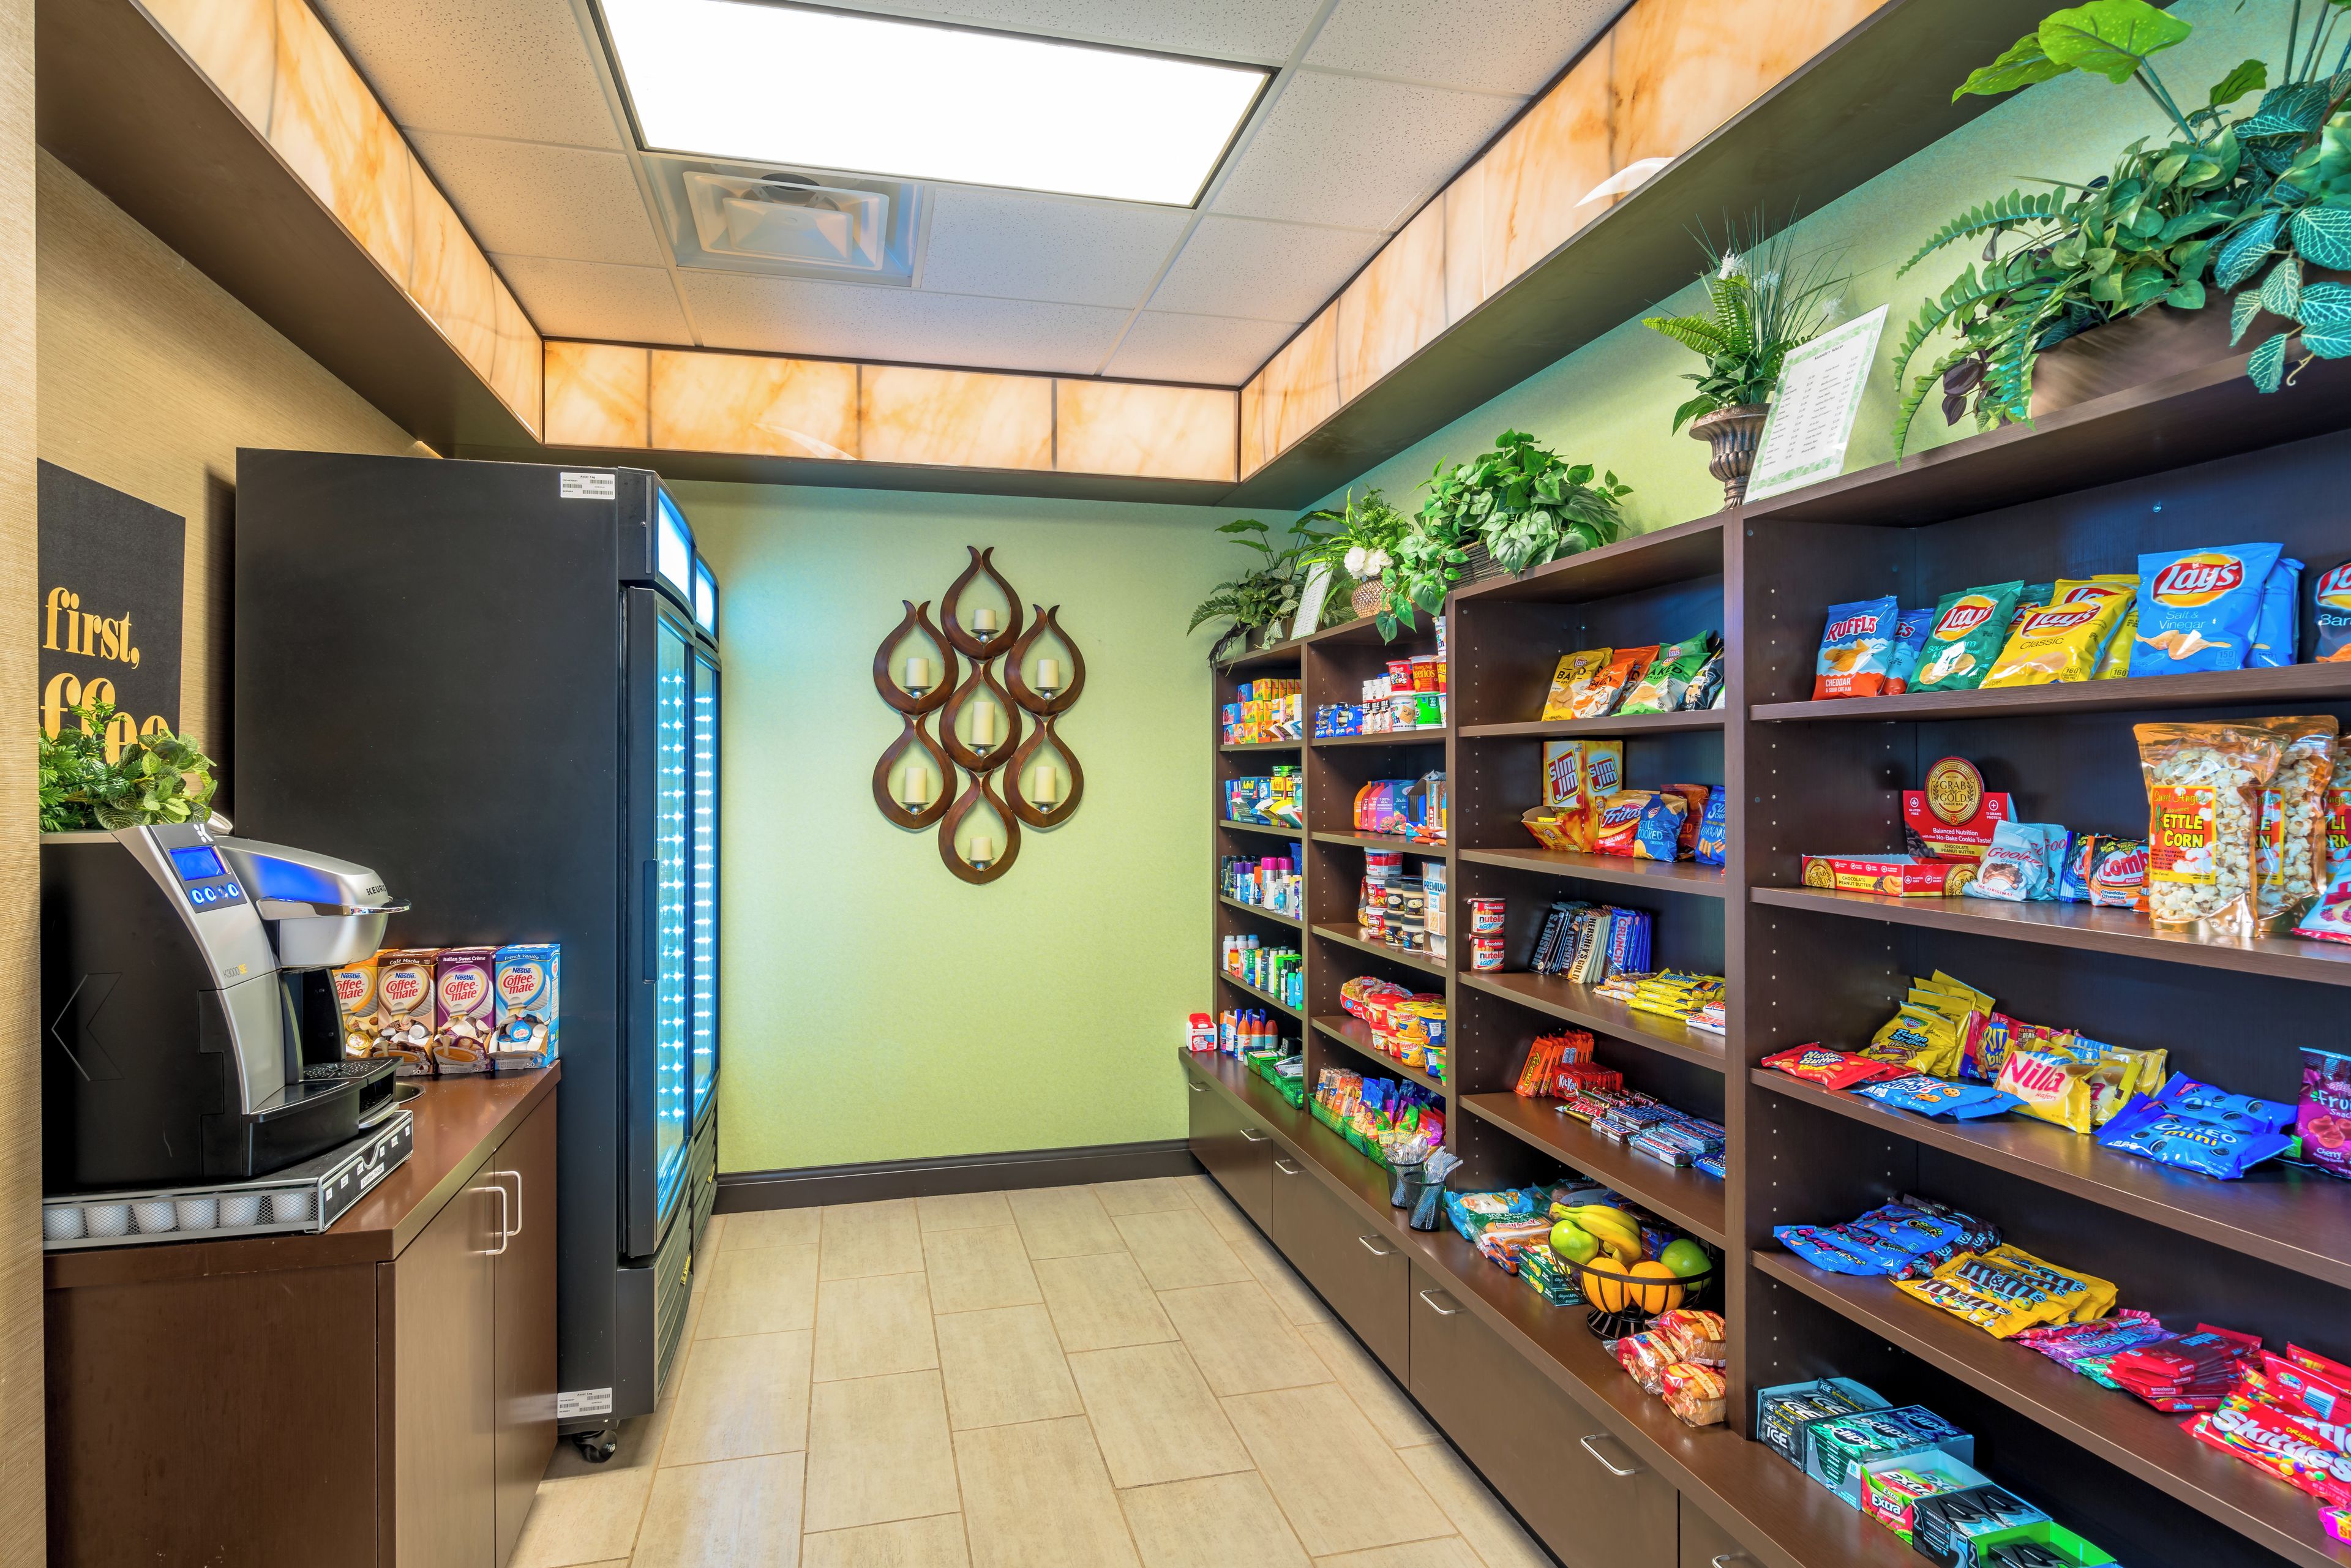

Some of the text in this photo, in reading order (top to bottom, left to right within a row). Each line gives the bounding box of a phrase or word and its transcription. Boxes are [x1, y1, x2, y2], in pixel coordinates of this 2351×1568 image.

[2156, 562, 2241, 595] Lay's
[1939, 601, 1998, 632] Lay's
[2024, 606, 2101, 631] Lay's
[2165, 611, 2189, 620] Salt
[43, 587, 140, 669] first,
[1824, 614, 1877, 642] RUFFLES
[2159, 619, 2207, 631] Vinegar
[1928, 643, 1946, 653] Sour
[2020, 636, 2065, 650] Classic
[1242, 780, 1254, 789] Advil
[1940, 781, 1966, 790] GRAB
[1940, 793, 1967, 803] GOLD
[1601, 806, 1642, 827] Fritos
[1637, 829, 1663, 841] COOKED
[2164, 830, 2204, 849] CORN
[1810, 870, 1826, 879] GRAB
[1423, 880, 1446, 893] PREMIUM
[1812, 879, 1829, 887] GOLD
[1987, 886, 2014, 898] ORIGINAL
[1613, 918, 1627, 965] CRUNCH
[1572, 918, 1597, 980] HERSHEY'S GOLD
[392, 988, 419, 1000] mate
[509, 982, 534, 994] mate
[451, 989, 478, 1002] mate
[1903, 1017, 1921, 1028] Keebler
[1890, 1034, 1928, 1048] Stripes
[1897, 1029, 1929, 1042] Fudge
[1799, 1054, 1842, 1065] Butter
[1524, 1052, 1541, 1087] Reese's
[2000, 1051, 2066, 1093] Nilla
[2036, 1092, 2057, 1101] wafers
[1569, 1101, 1605, 1118] TWIX
[2153, 1122, 2238, 1144] OREO
[2163, 1129, 2218, 1147] mini
[2317, 1147, 2342, 1160] Cherry
[373, 1166, 383, 1177] Pods
[1820, 1384, 1832, 1392] ICE
[1860, 1417, 1921, 1443] eclipse
[1896, 1411, 1958, 1436] eclipse
[1766, 1426, 1788, 1449] ICE
[1822, 1423, 1883, 1450] eclipse
[2211, 1408, 2351, 1483] Skittles
[1883, 1487, 1900, 1501] Extra
[1871, 1493, 1901, 1515] Extra
[1926, 1510, 1946, 1525] WINTERMINT
[1926, 1521, 1946, 1536] WINTERMINT
